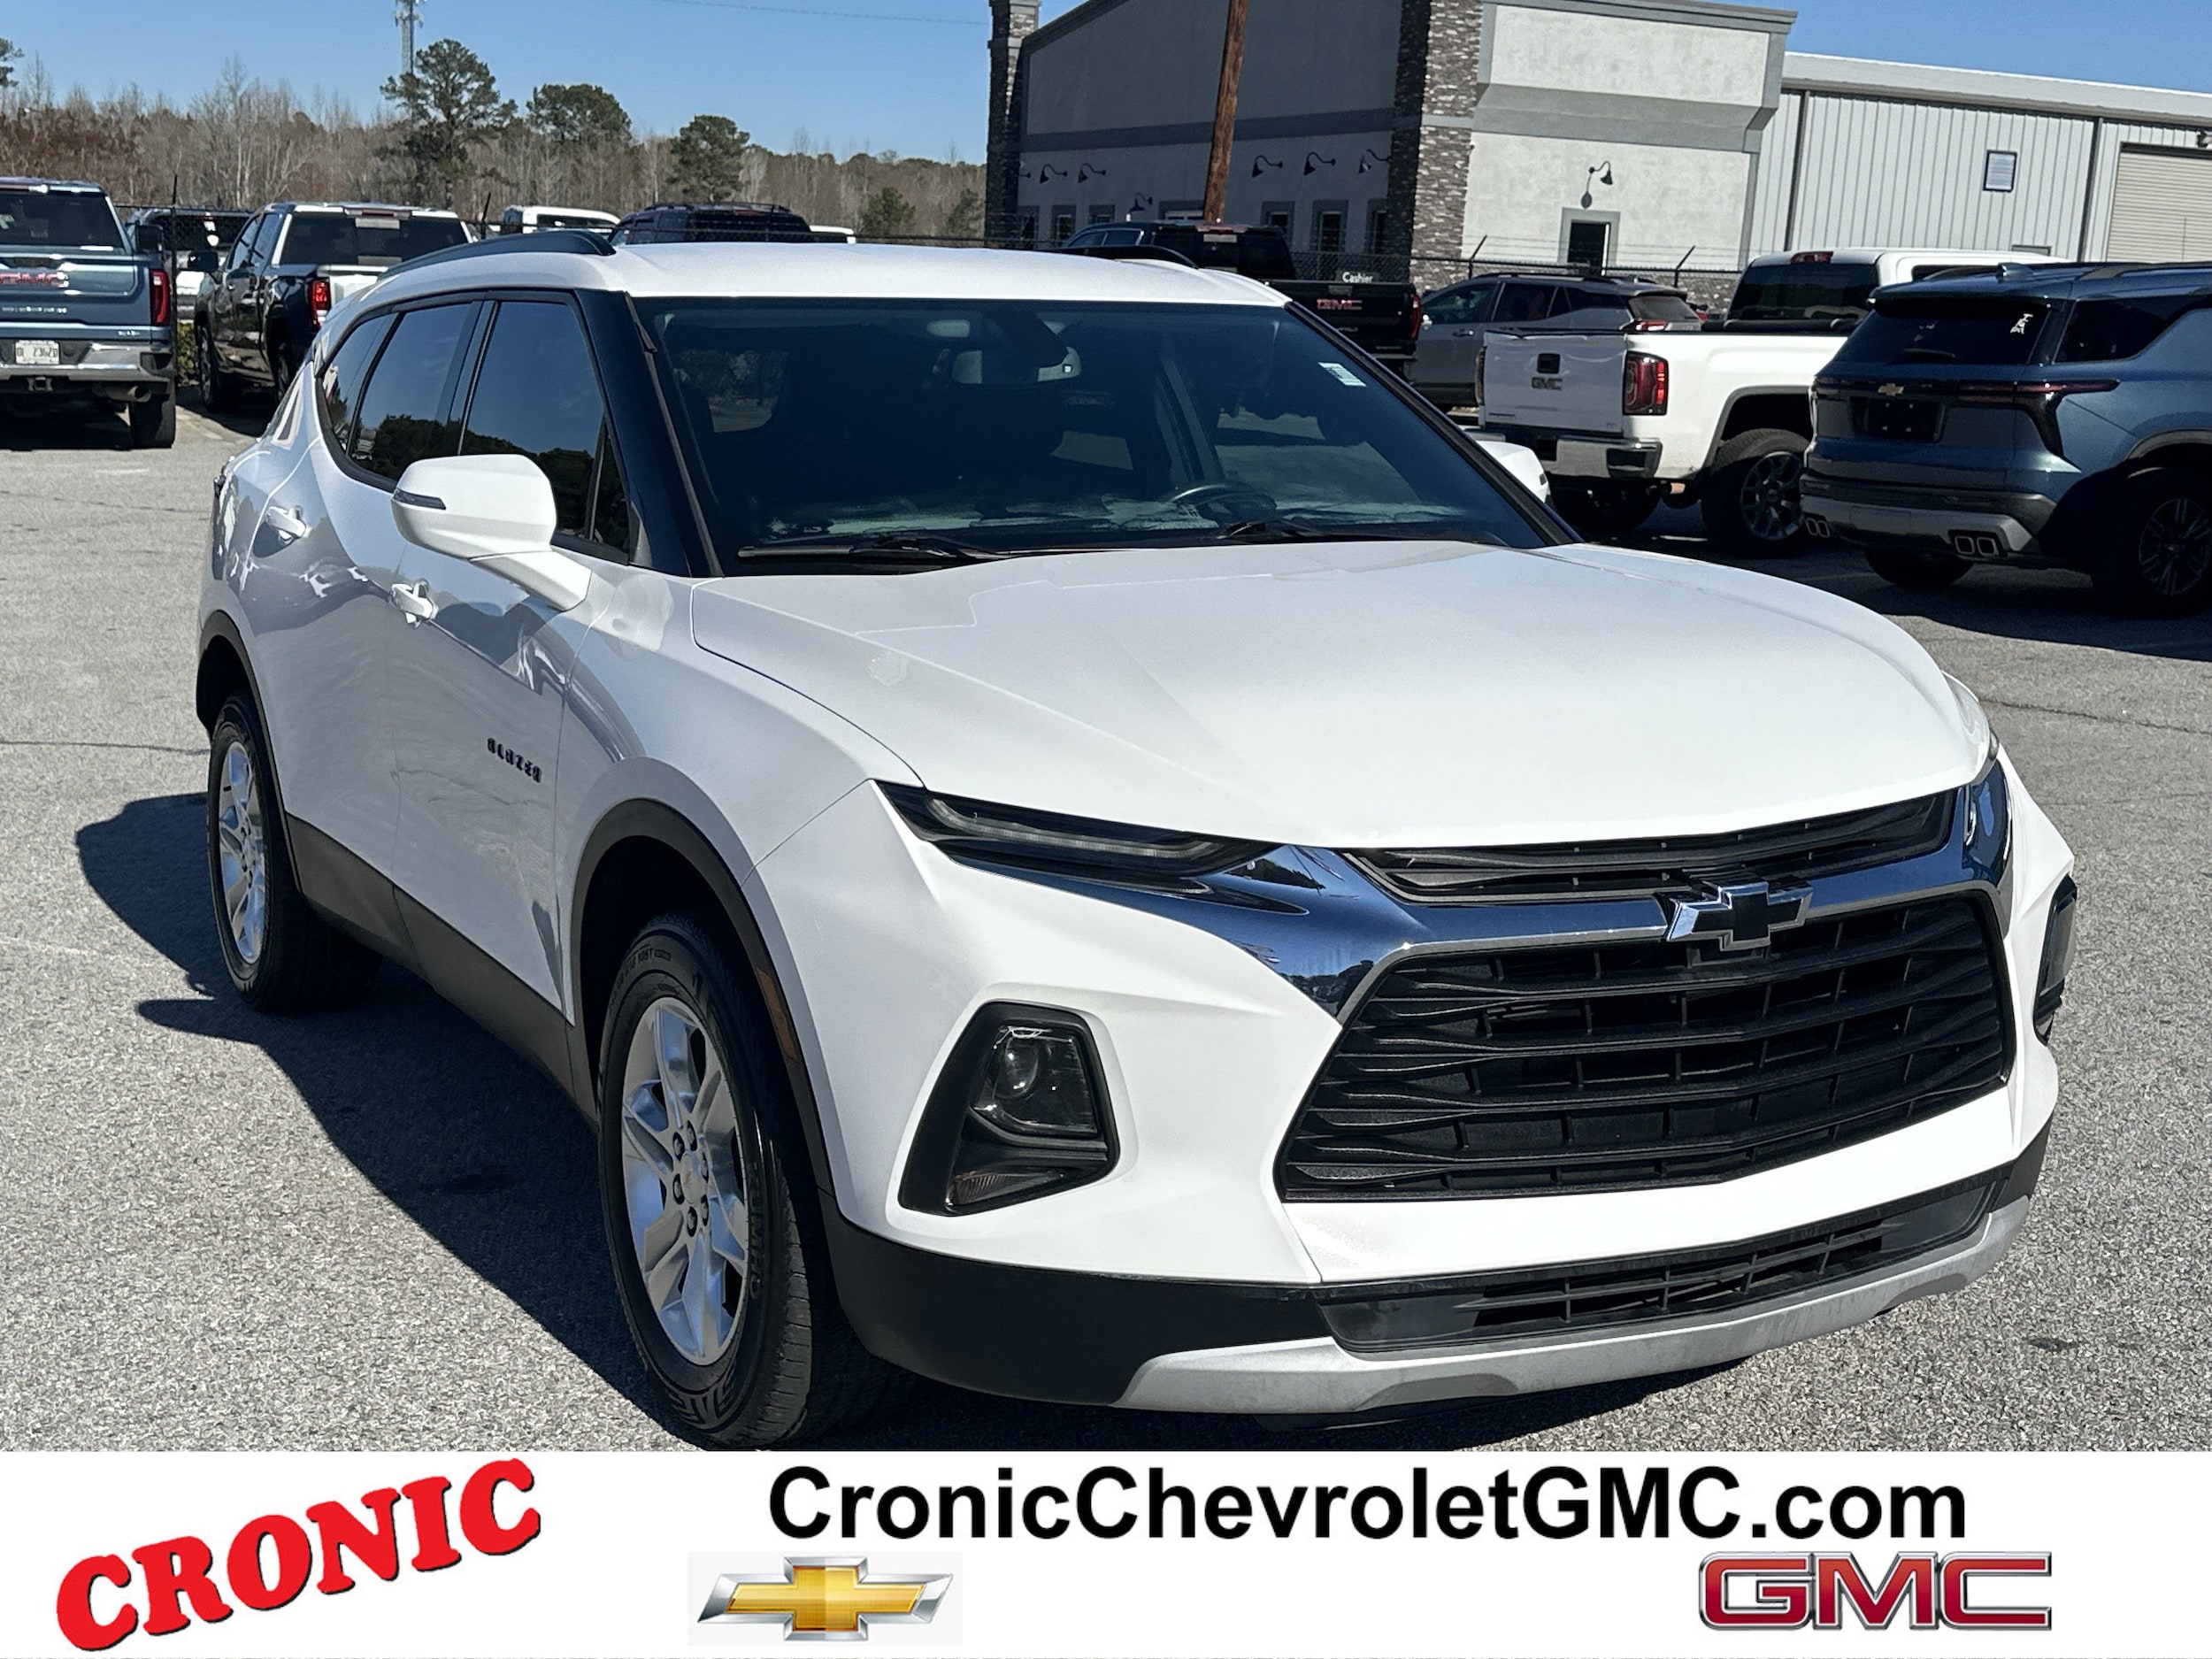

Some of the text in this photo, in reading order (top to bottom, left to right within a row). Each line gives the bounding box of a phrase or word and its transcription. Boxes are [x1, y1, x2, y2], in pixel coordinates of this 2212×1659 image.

[1341, 271, 1374, 284] Cashier
[1531, 376, 1563, 390] GMC
[487, 737, 541, 783] BLAZER
